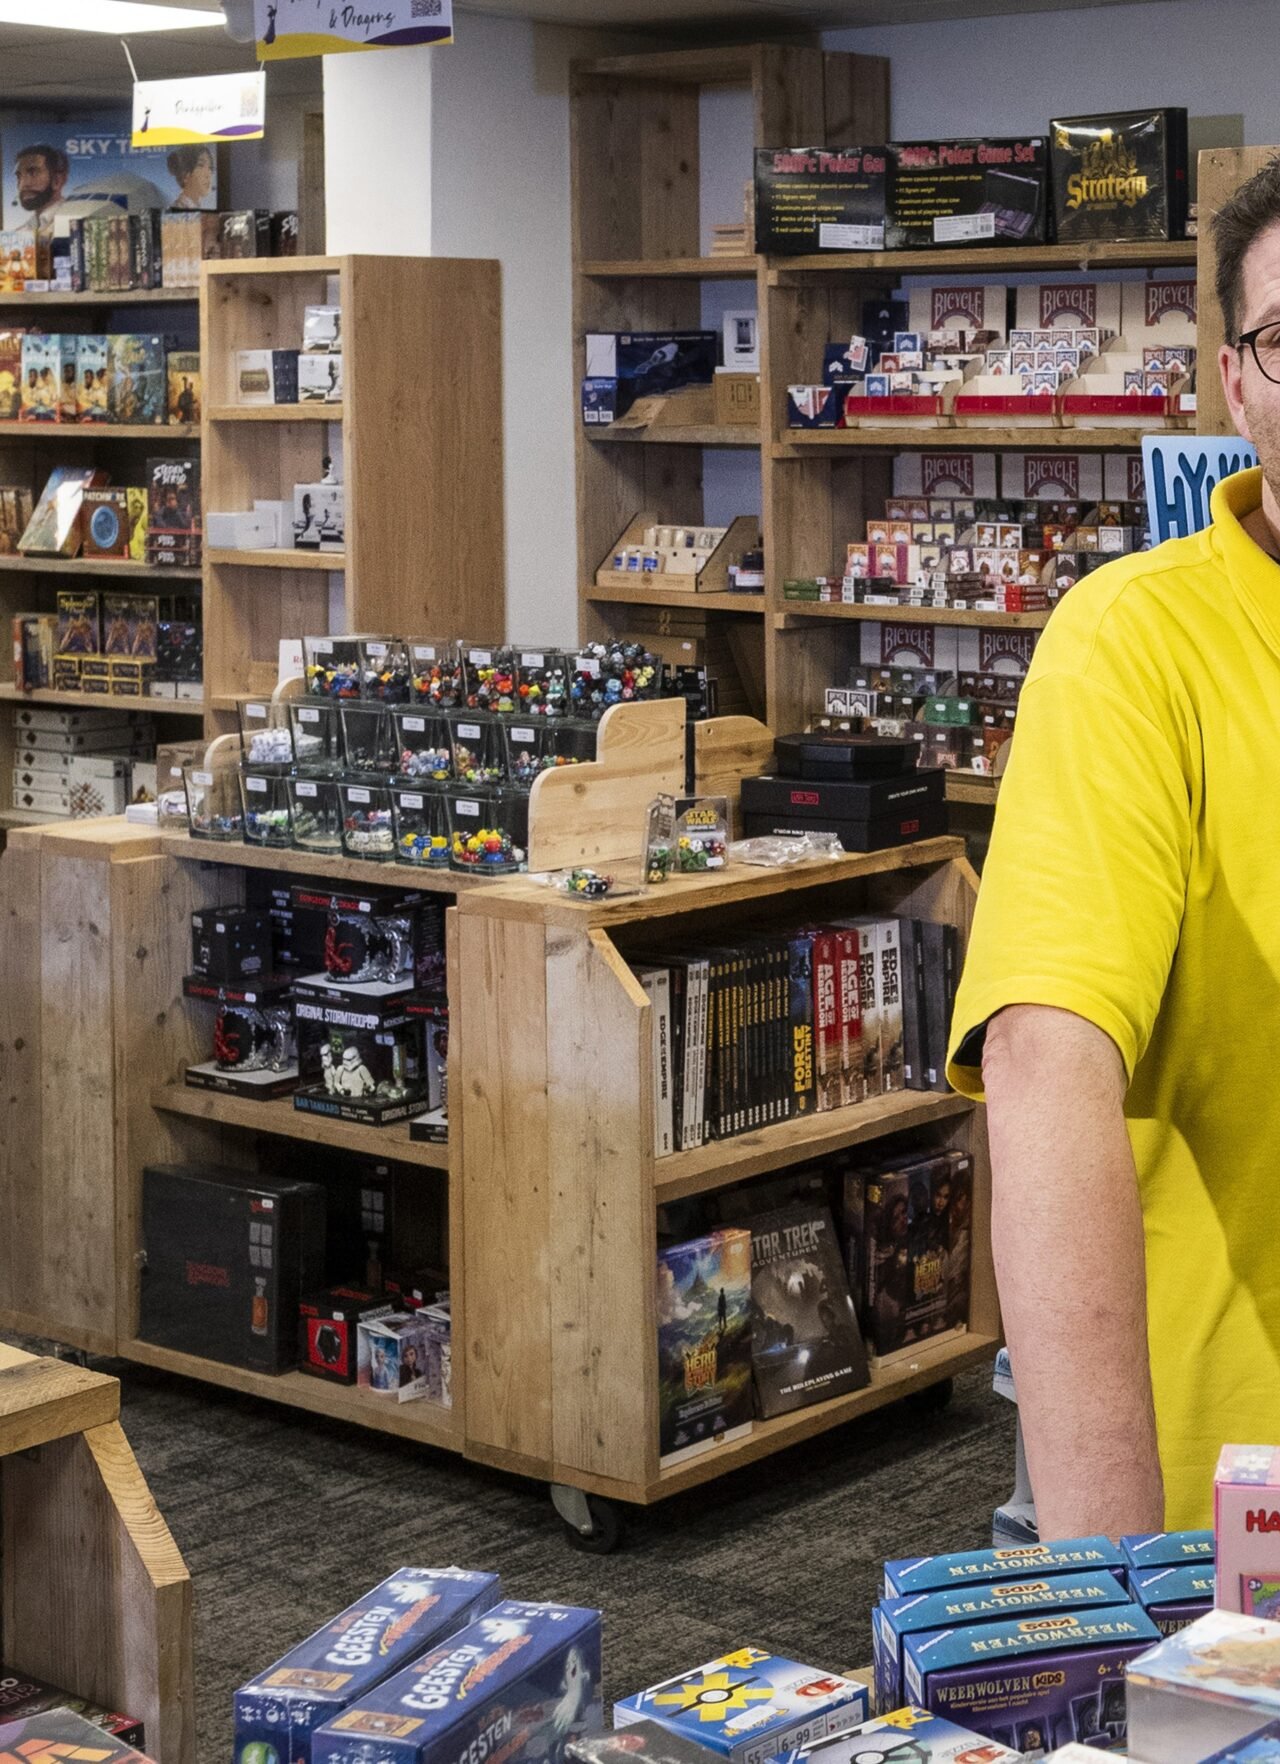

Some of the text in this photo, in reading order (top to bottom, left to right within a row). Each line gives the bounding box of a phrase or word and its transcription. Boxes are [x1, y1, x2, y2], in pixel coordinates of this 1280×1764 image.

[65, 139, 111, 155] SKY
[939, 146, 976, 166] Poker
[1014, 142, 1036, 163] Set
[1067, 172, 1148, 209] Stratego
[934, 291, 984, 328] BICYCLE
[1042, 288, 1095, 326] BICYCLE
[924, 456, 972, 494] BICYCLE
[1028, 456, 1077, 496] BICYCLE
[885, 626, 932, 660] BICYCLE
[984, 633, 1032, 665] BICYCLE
[793, 1025, 806, 1093] FORCE
[784, 1222, 820, 1251] TREK
[752, 1244, 819, 1269] ADVENTURES
[949, 1550, 1104, 1577] WEERWOLVEN
[945, 1586, 1107, 1616] WEERWOLVEN
[325, 1605, 396, 1666] GEESTEN
[970, 1621, 1137, 1653] WEERWOLVEN
[401, 1644, 484, 1711] GEESTEN
[936, 1672, 1064, 1703] WEERWOLVEN KIDS
[781, 1729, 811, 1753] 6-99
